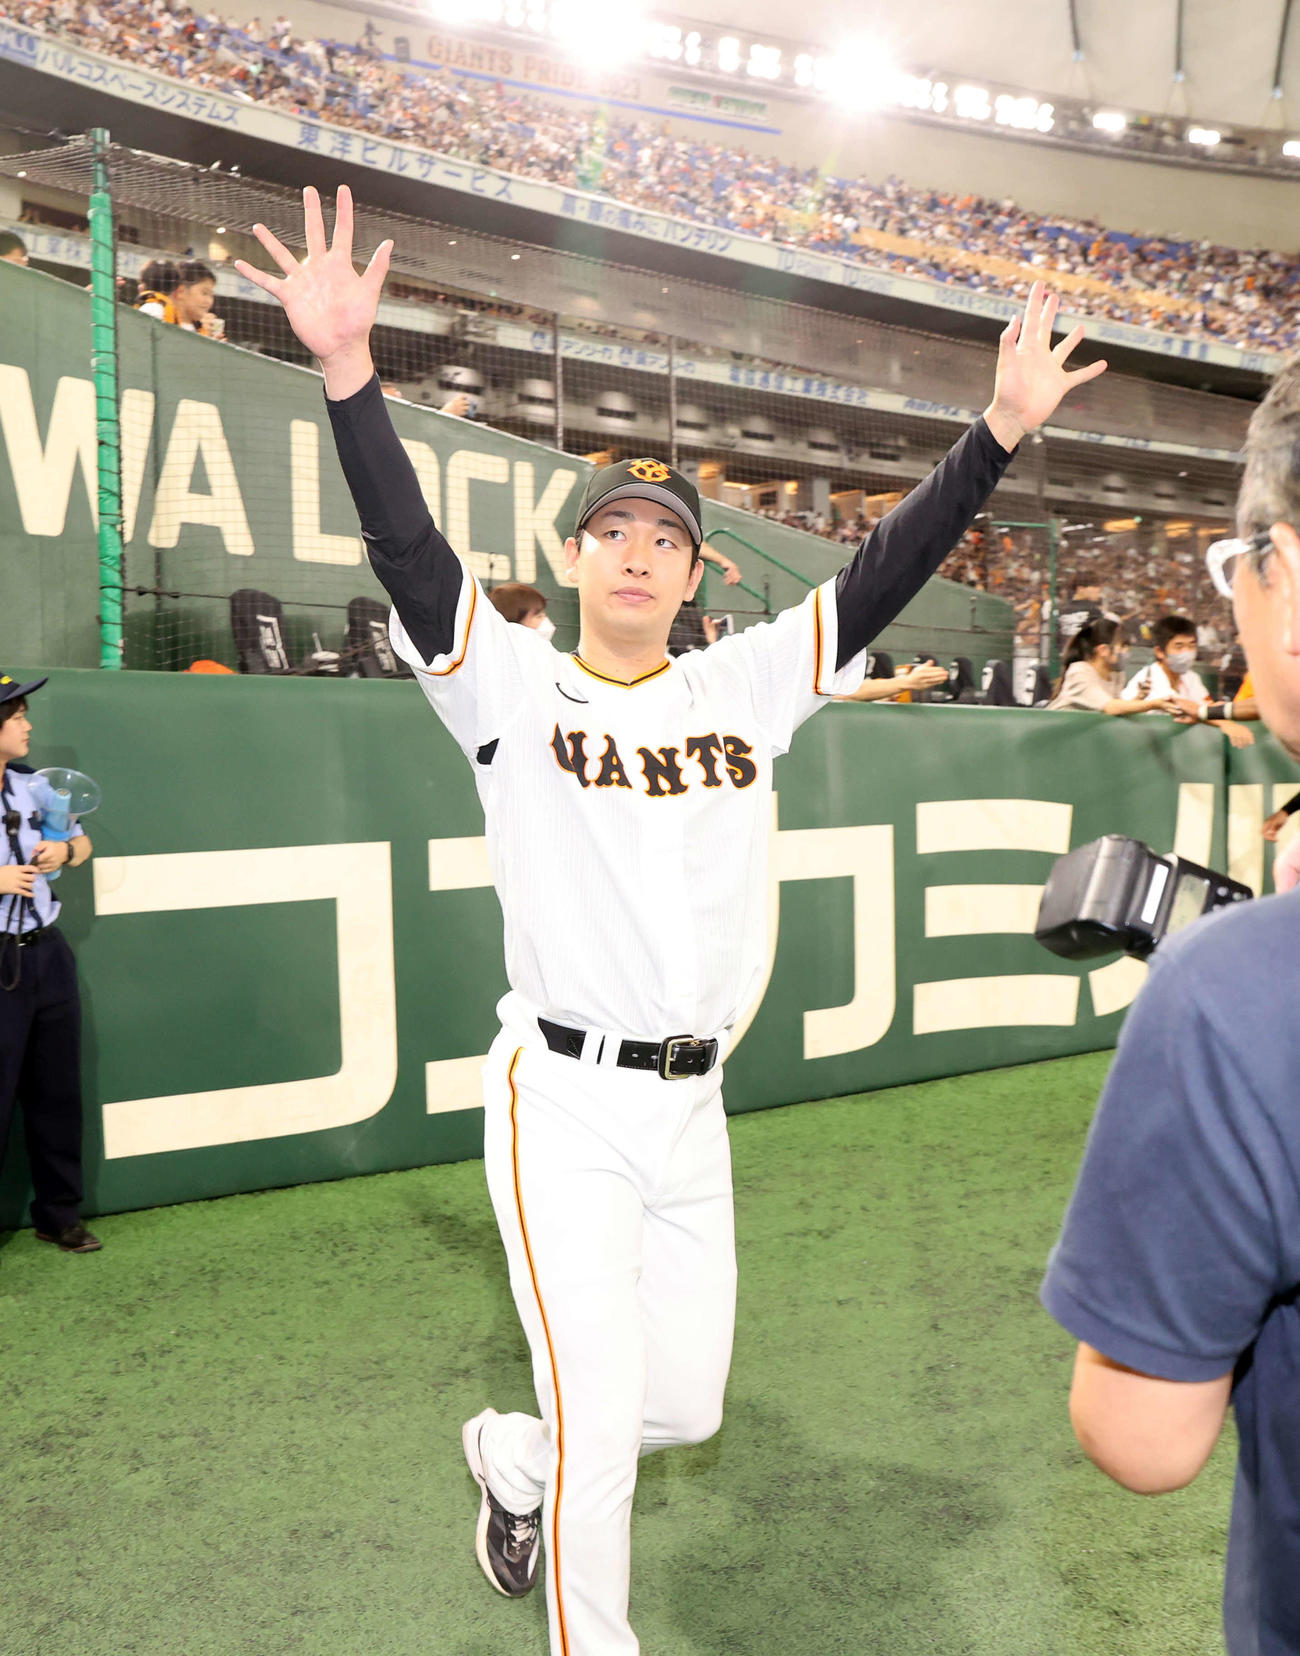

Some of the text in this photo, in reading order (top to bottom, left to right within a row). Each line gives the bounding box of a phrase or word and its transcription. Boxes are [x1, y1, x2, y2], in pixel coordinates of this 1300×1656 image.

[298, 124, 513, 200] 東洋ビルサービス
